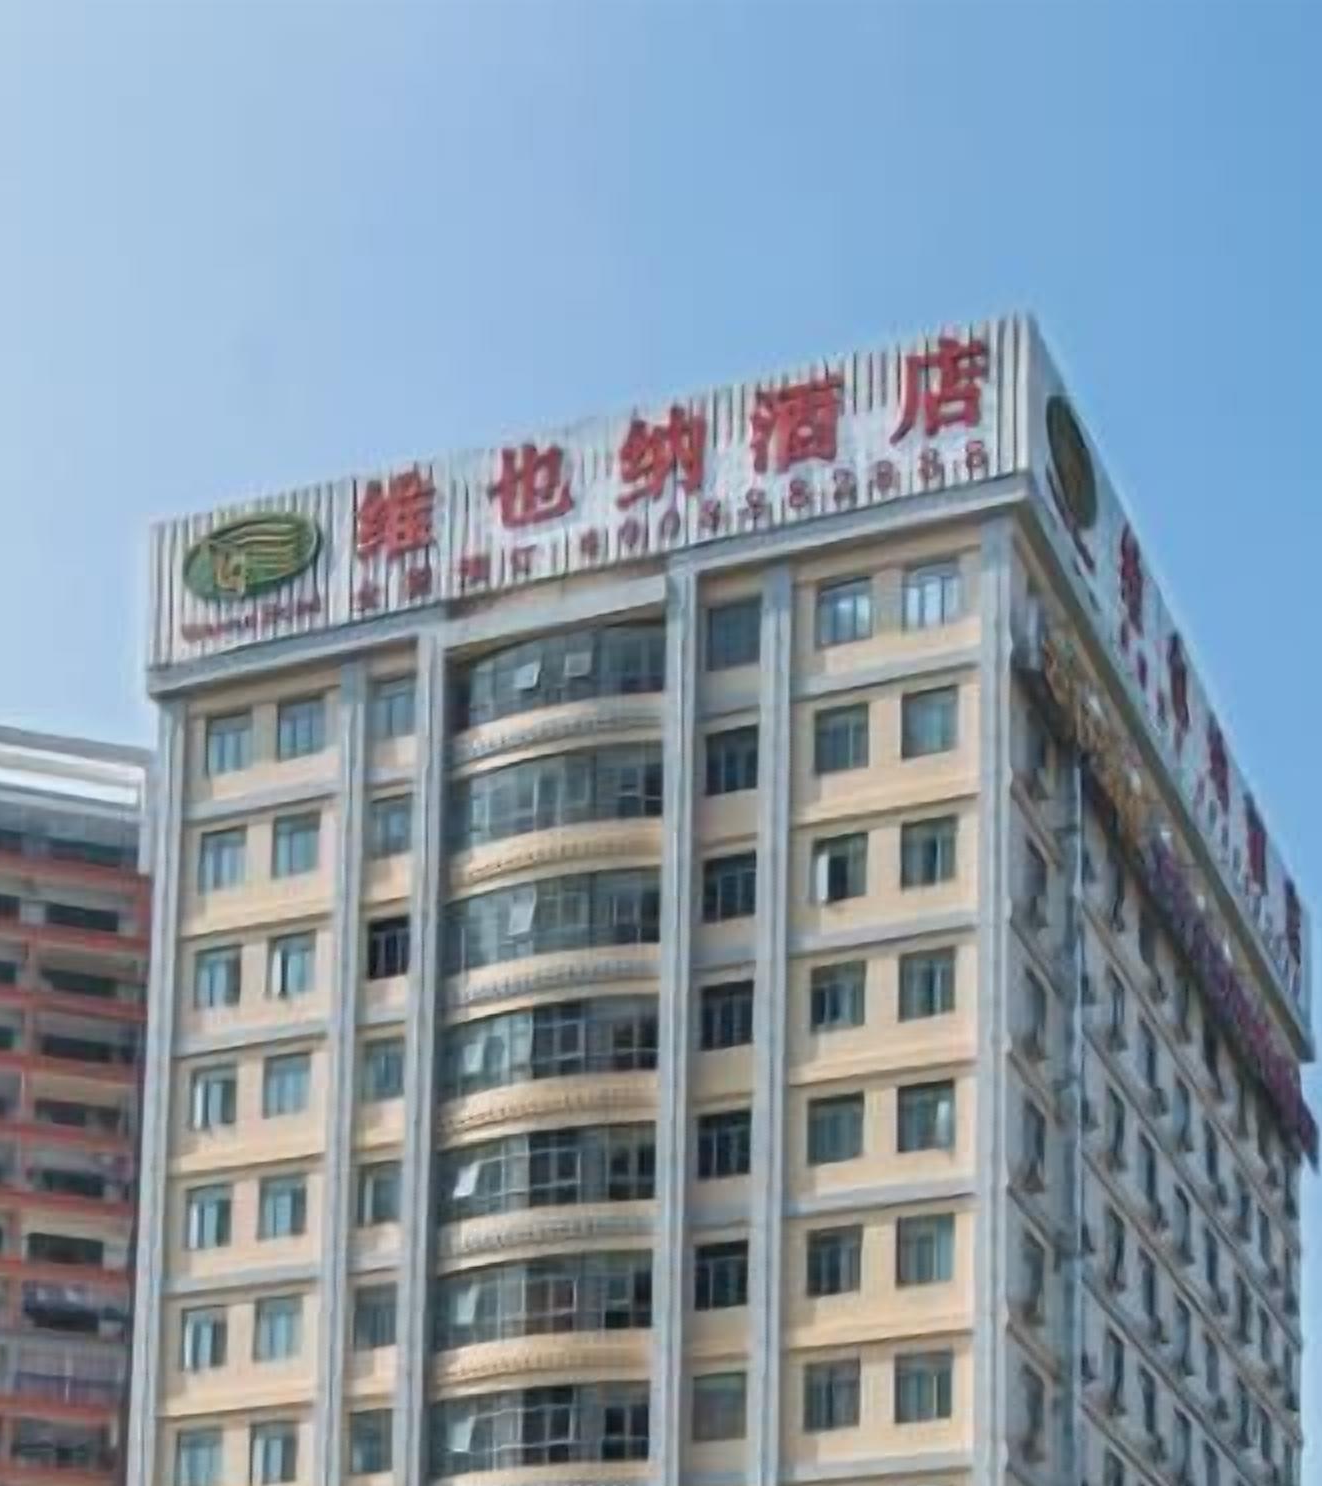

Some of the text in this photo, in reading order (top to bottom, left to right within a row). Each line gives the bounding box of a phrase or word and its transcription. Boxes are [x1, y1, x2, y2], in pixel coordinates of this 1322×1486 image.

[356, 337, 989, 563] 维也纳酒店
